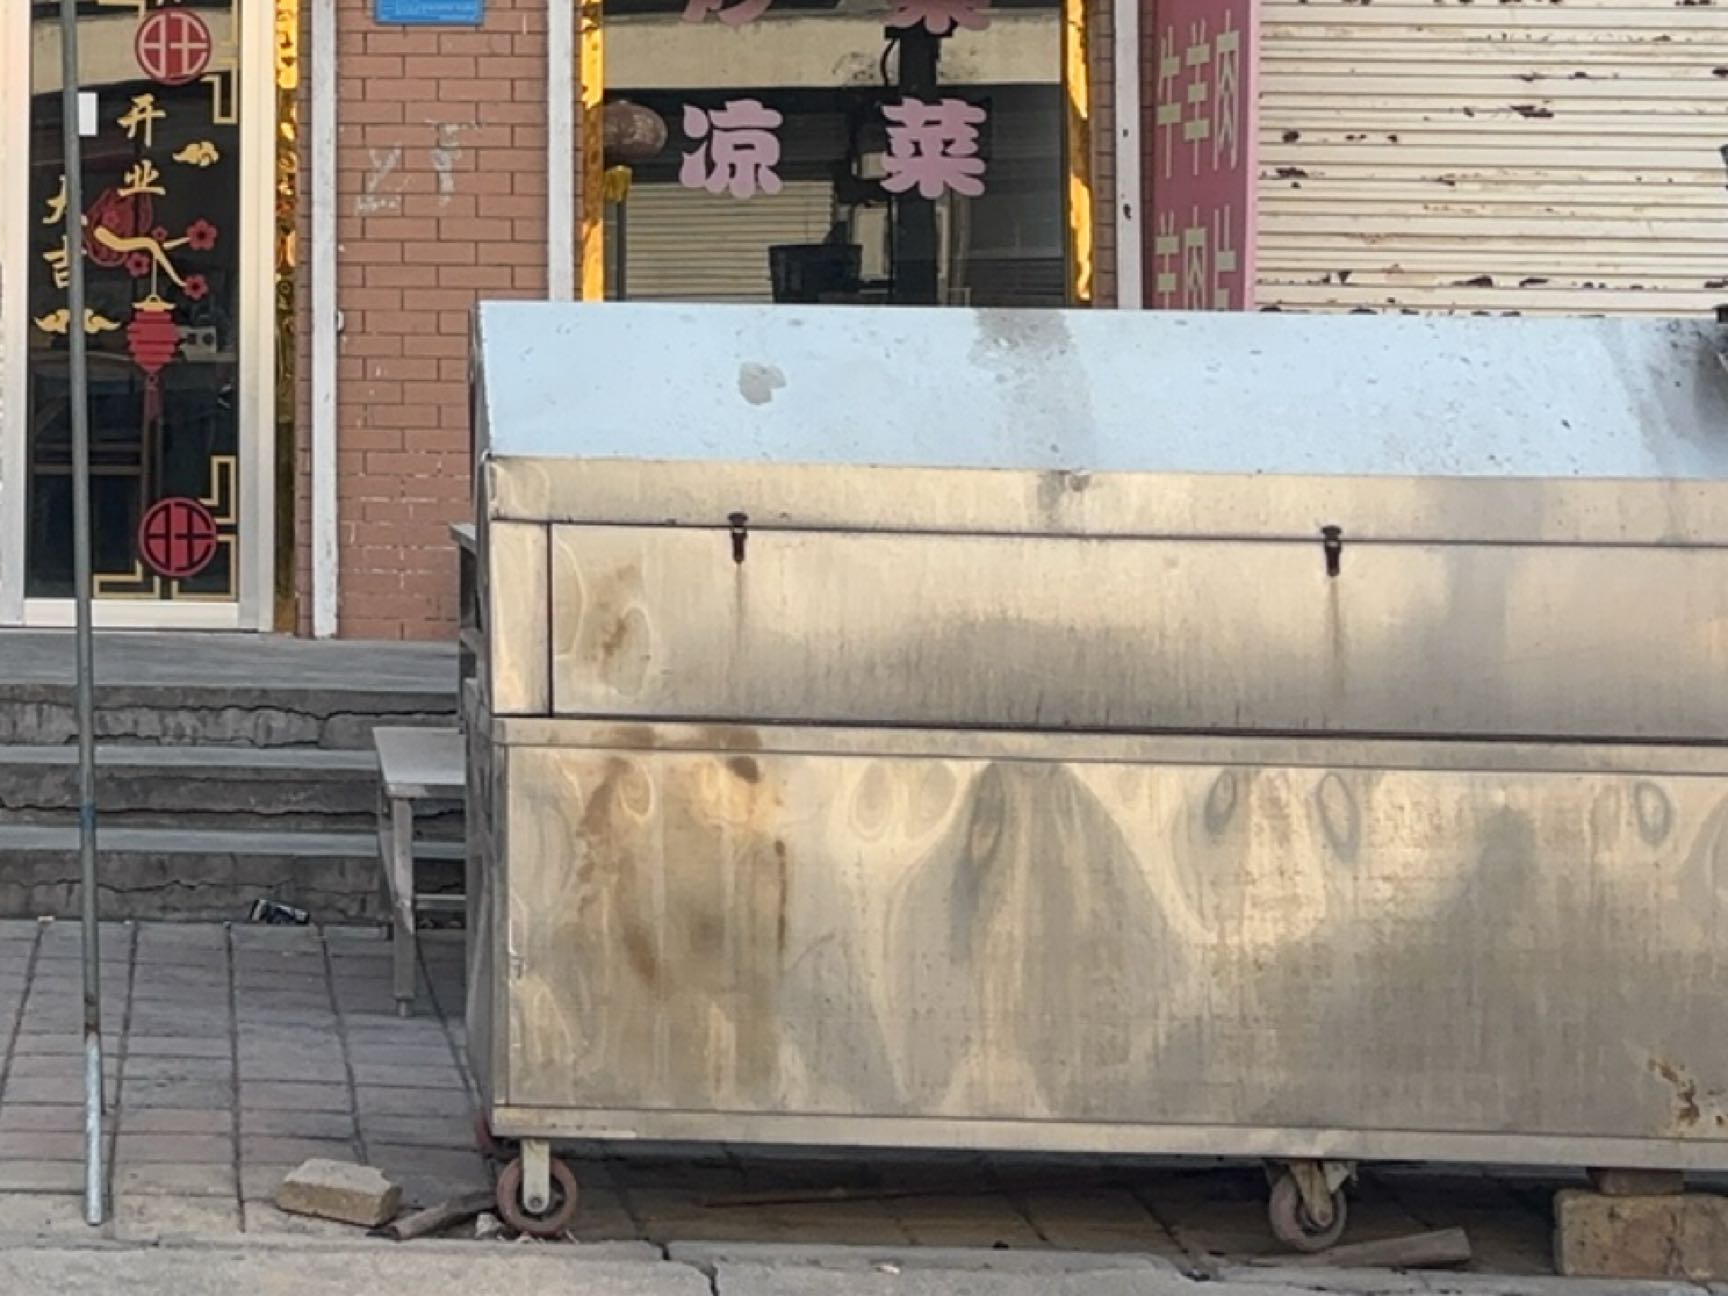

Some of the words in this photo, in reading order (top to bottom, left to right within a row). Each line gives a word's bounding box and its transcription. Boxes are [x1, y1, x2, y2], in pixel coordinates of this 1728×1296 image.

[117, 93, 166, 196] 开业
[1156, 9, 1240, 179] 牛羊肉
[679, 98, 987, 200] 凉菜
